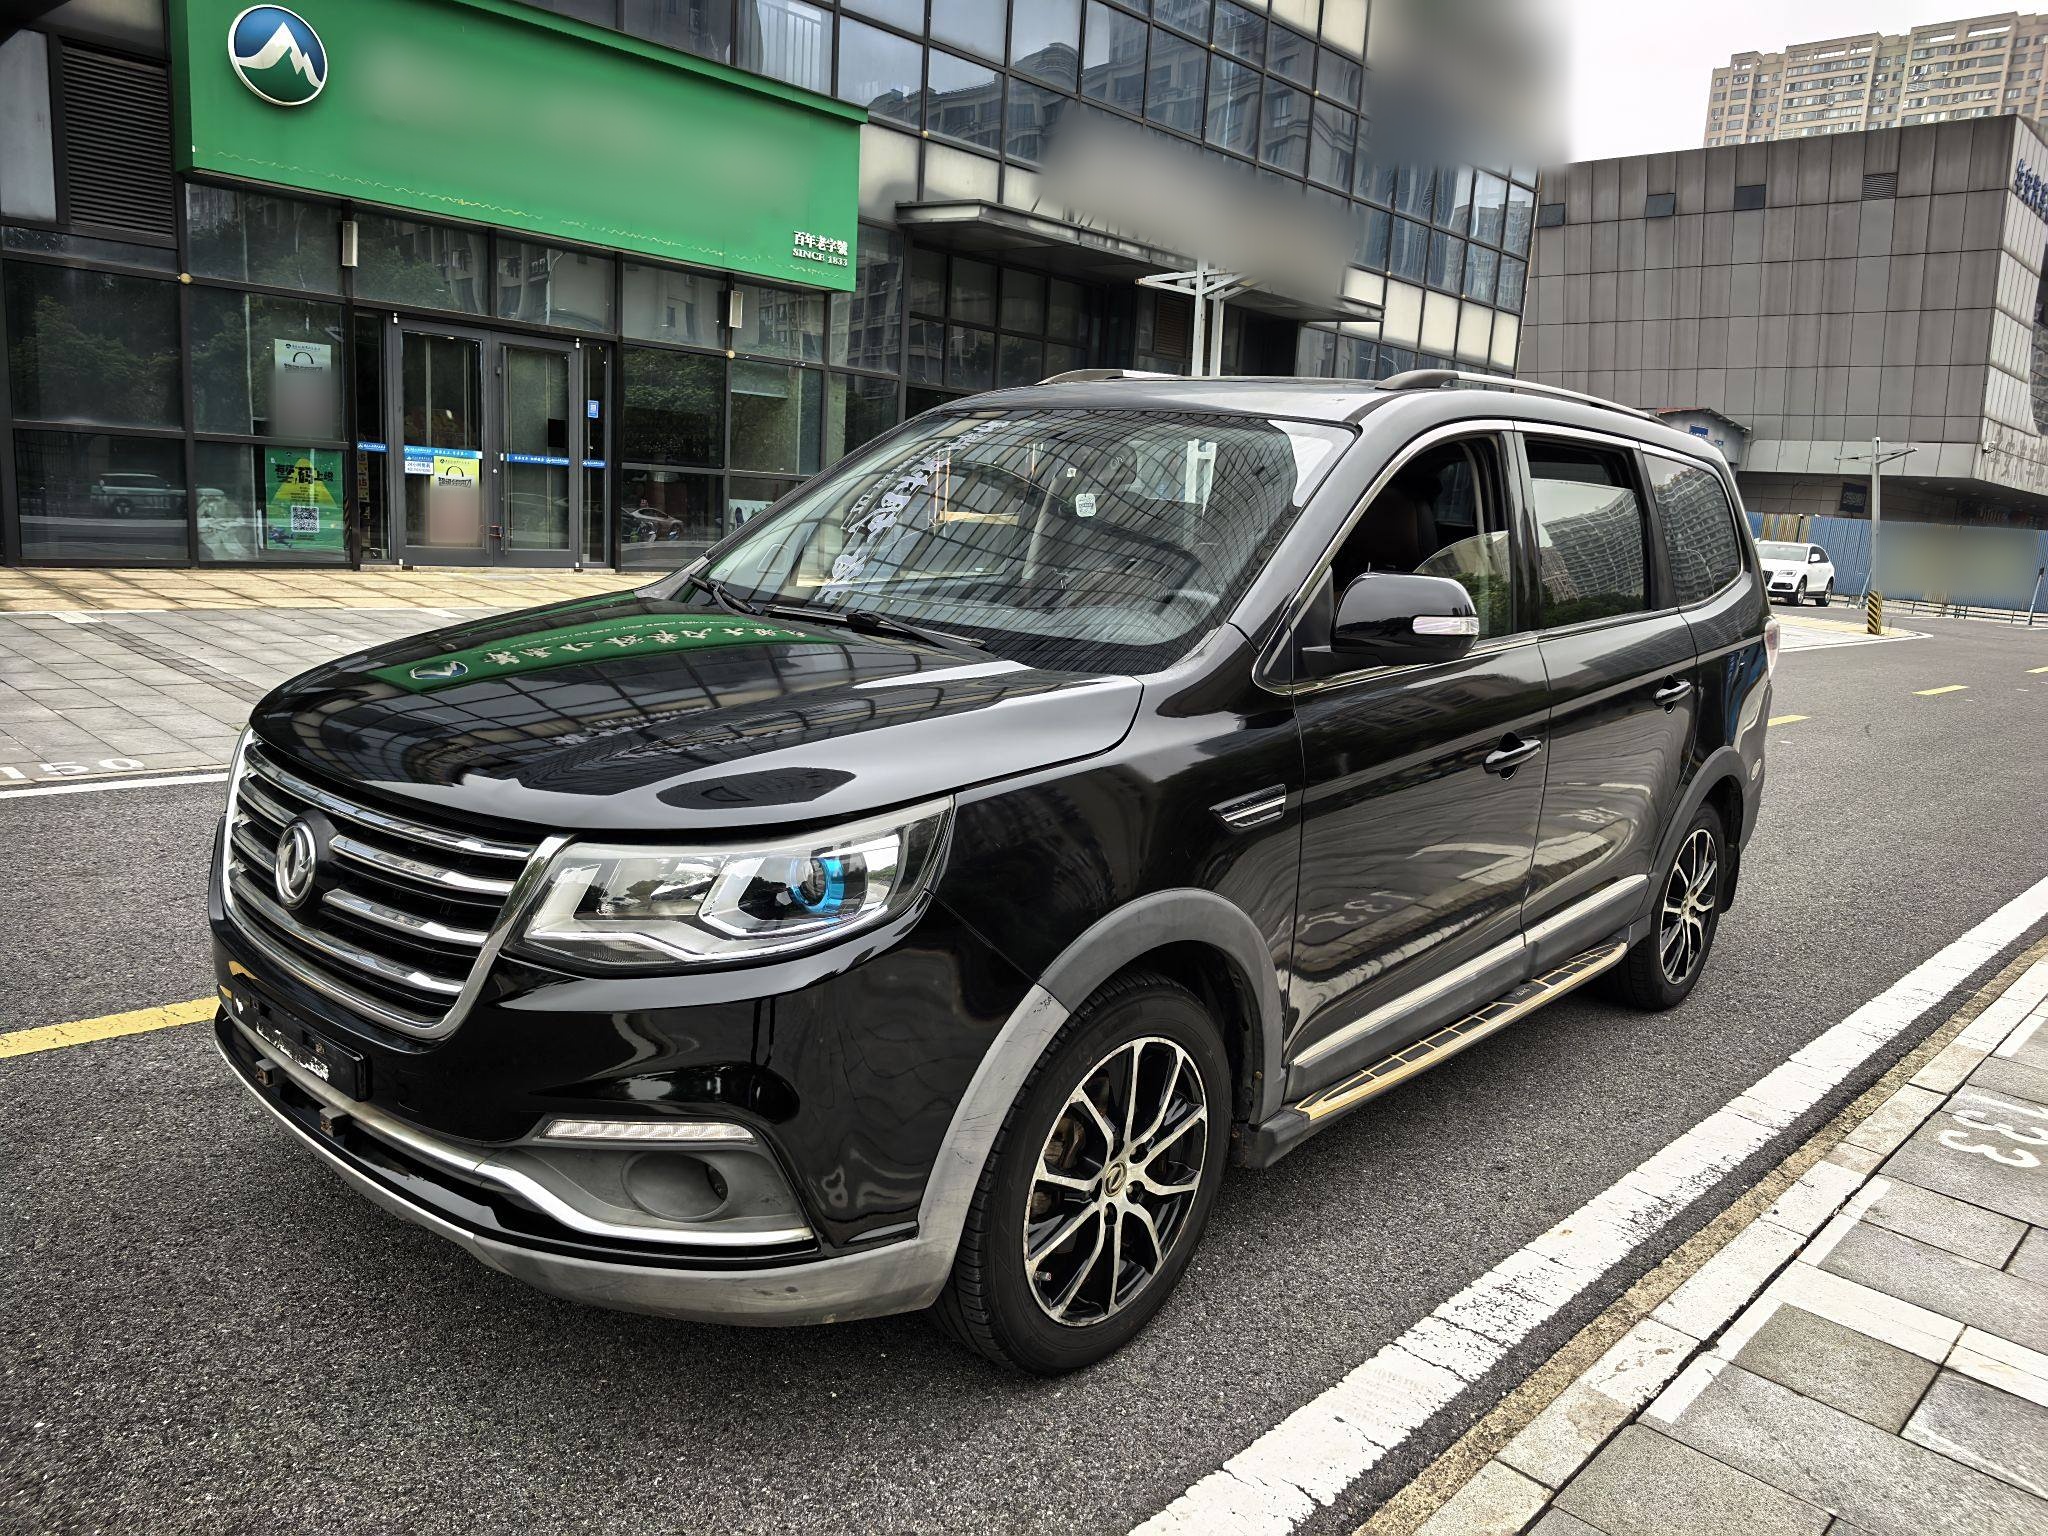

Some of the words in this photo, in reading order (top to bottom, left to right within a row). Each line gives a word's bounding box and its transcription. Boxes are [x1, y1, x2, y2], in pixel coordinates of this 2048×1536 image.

[792, 247, 825, 262] SINCE
[827, 255, 848, 267] 1833
[0, 758, 145, 780] 150
